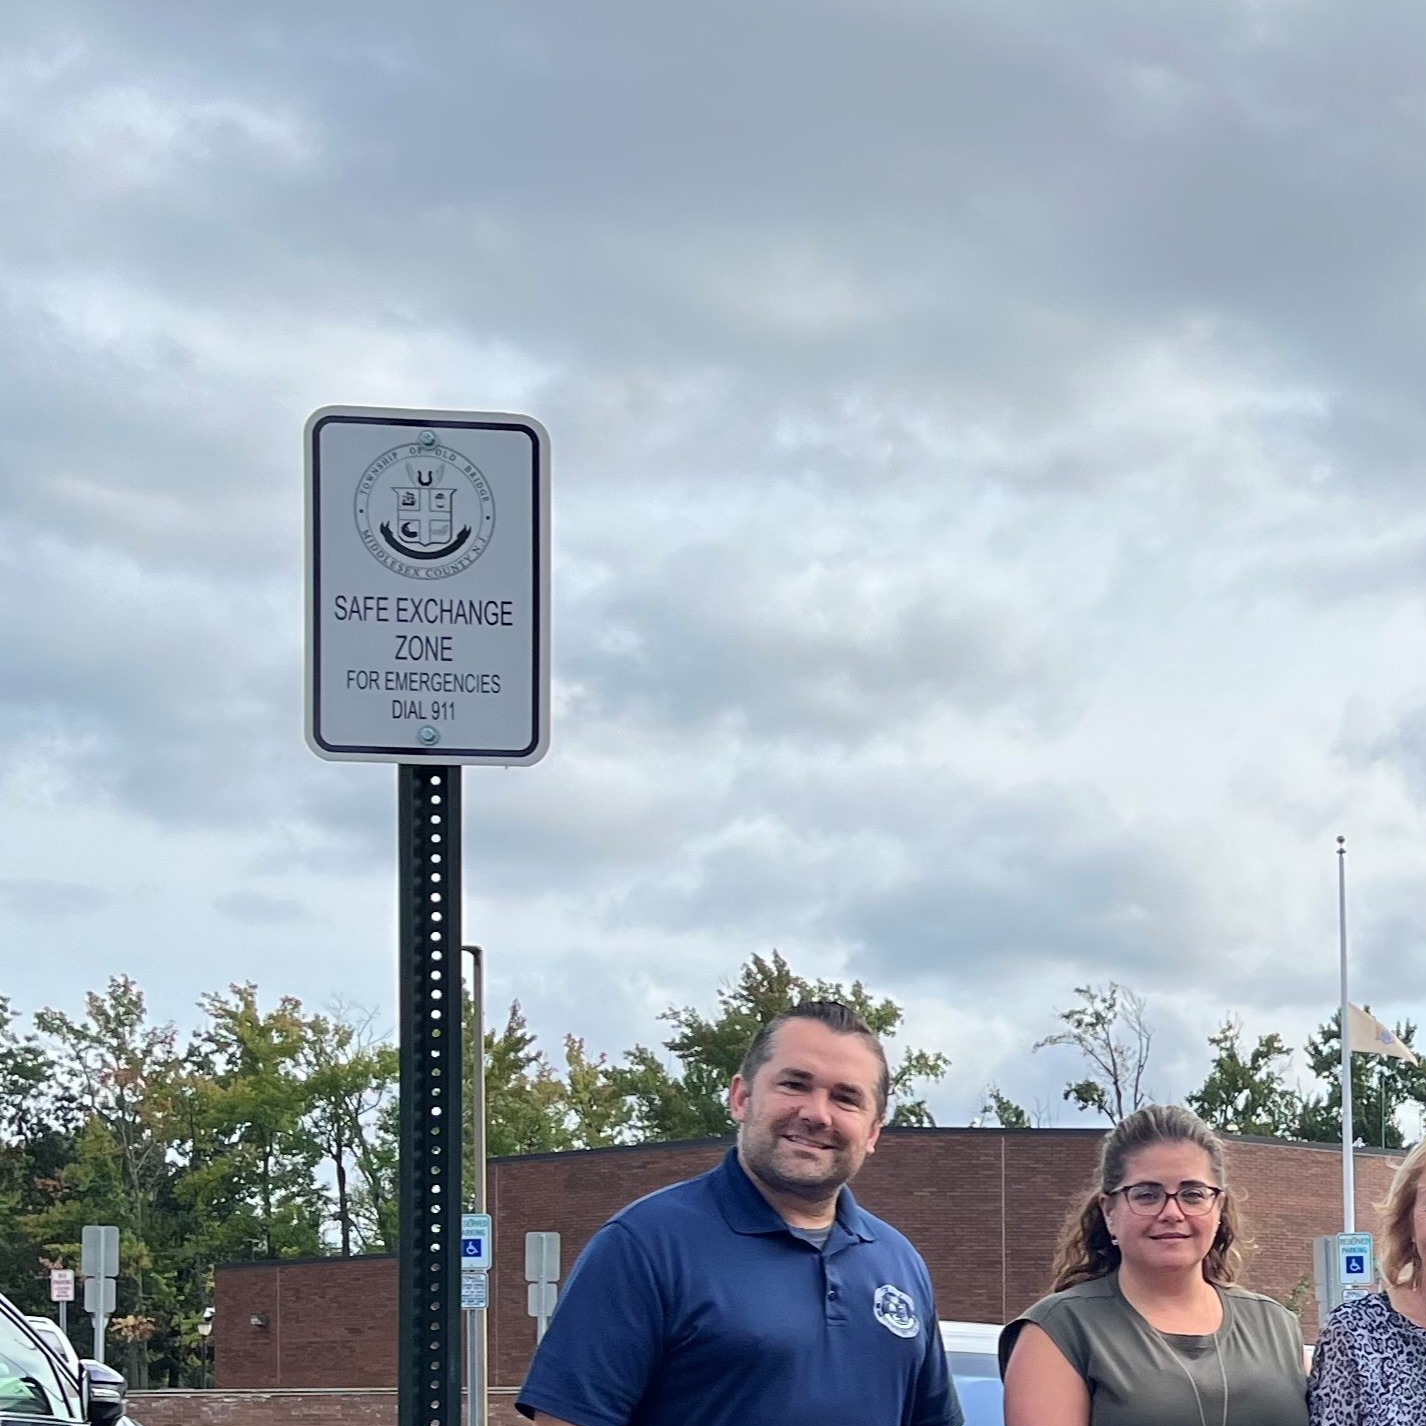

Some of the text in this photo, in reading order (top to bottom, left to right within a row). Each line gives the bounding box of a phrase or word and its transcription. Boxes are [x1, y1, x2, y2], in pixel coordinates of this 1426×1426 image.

[359, 451, 398, 495] TOWNSHIP
[434, 448, 457, 462] OLD
[463, 464, 490, 502] BRIDGE
[361, 528, 421, 577] MIDDLESEX
[424, 554, 474, 578] COUNTY
[334, 595, 514, 626] SAFE EXCHANGE
[394, 635, 453, 662] ZONE
[346, 669, 501, 694] FOR EMERGENCIES
[391, 699, 456, 721] DIAL 911
[462, 1229, 486, 1237] ARKING
